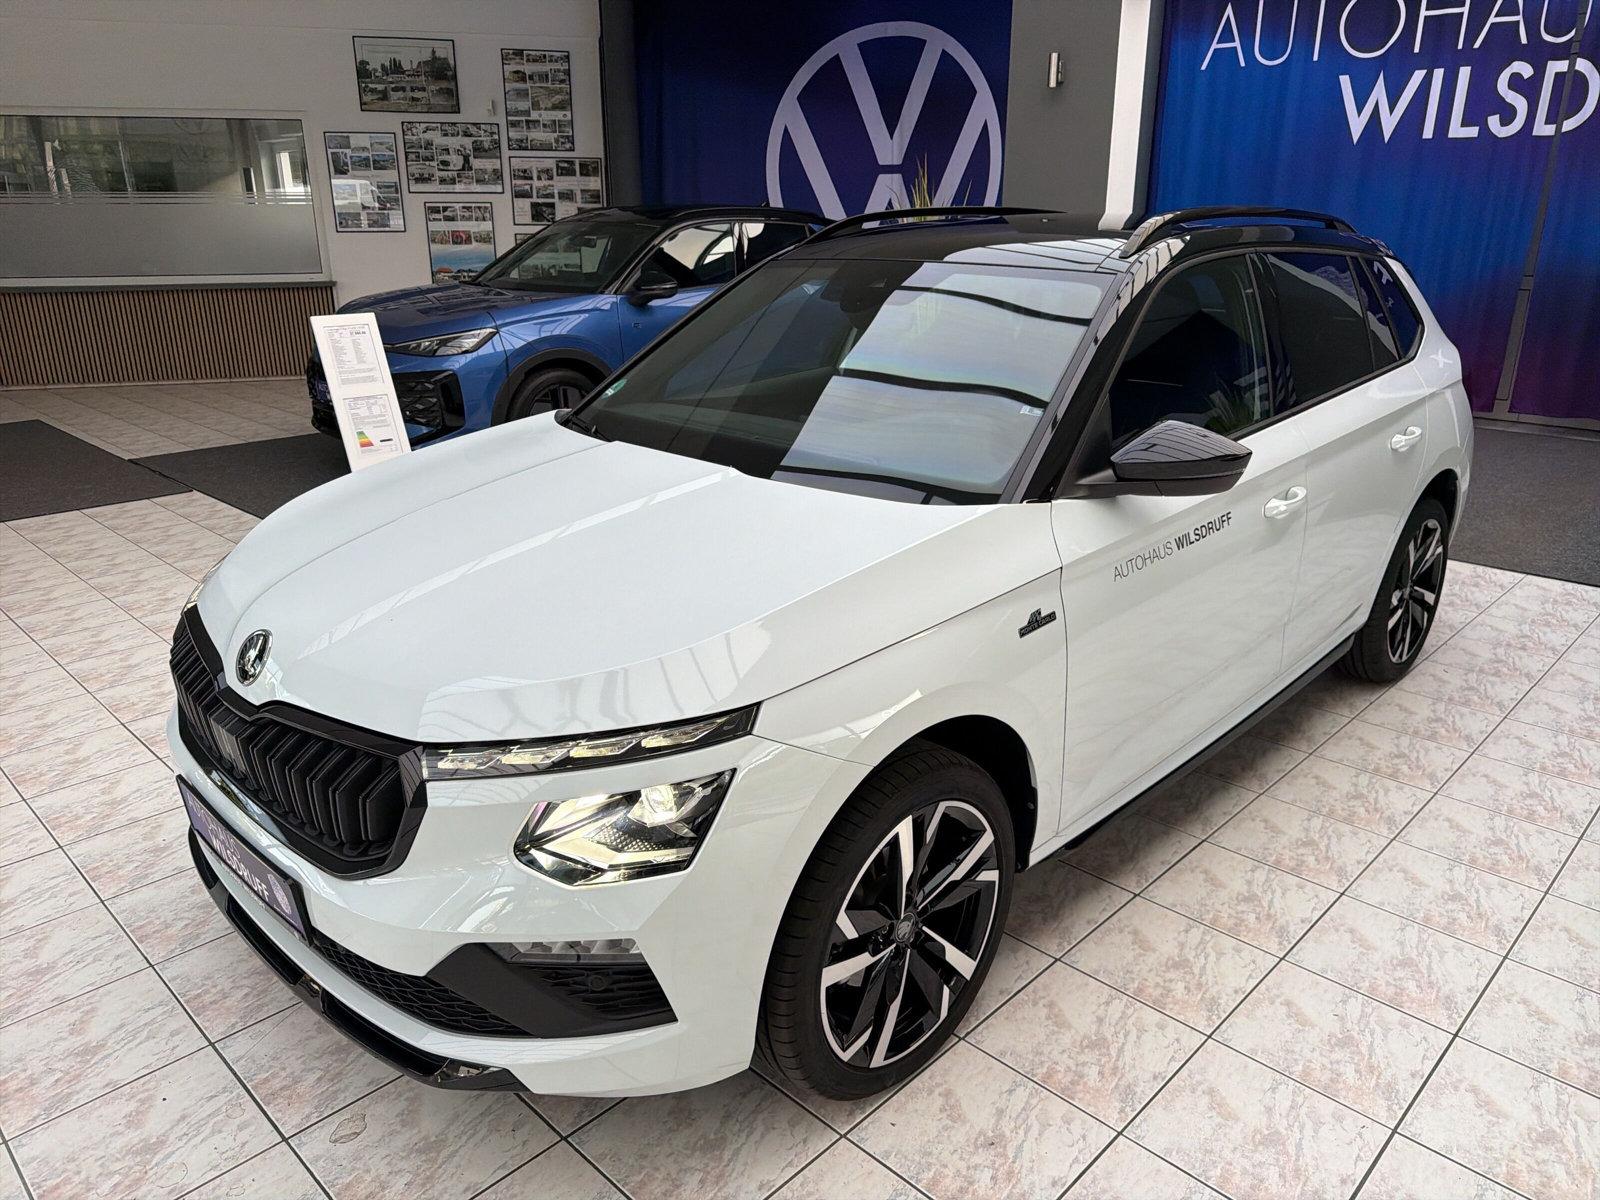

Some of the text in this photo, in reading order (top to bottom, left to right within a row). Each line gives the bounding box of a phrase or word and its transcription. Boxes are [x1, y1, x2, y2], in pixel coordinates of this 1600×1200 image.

[1113, 511, 1232, 582] AUTOHAUS WILSDRUFF
[208, 829, 270, 902] WILSDRUFF
